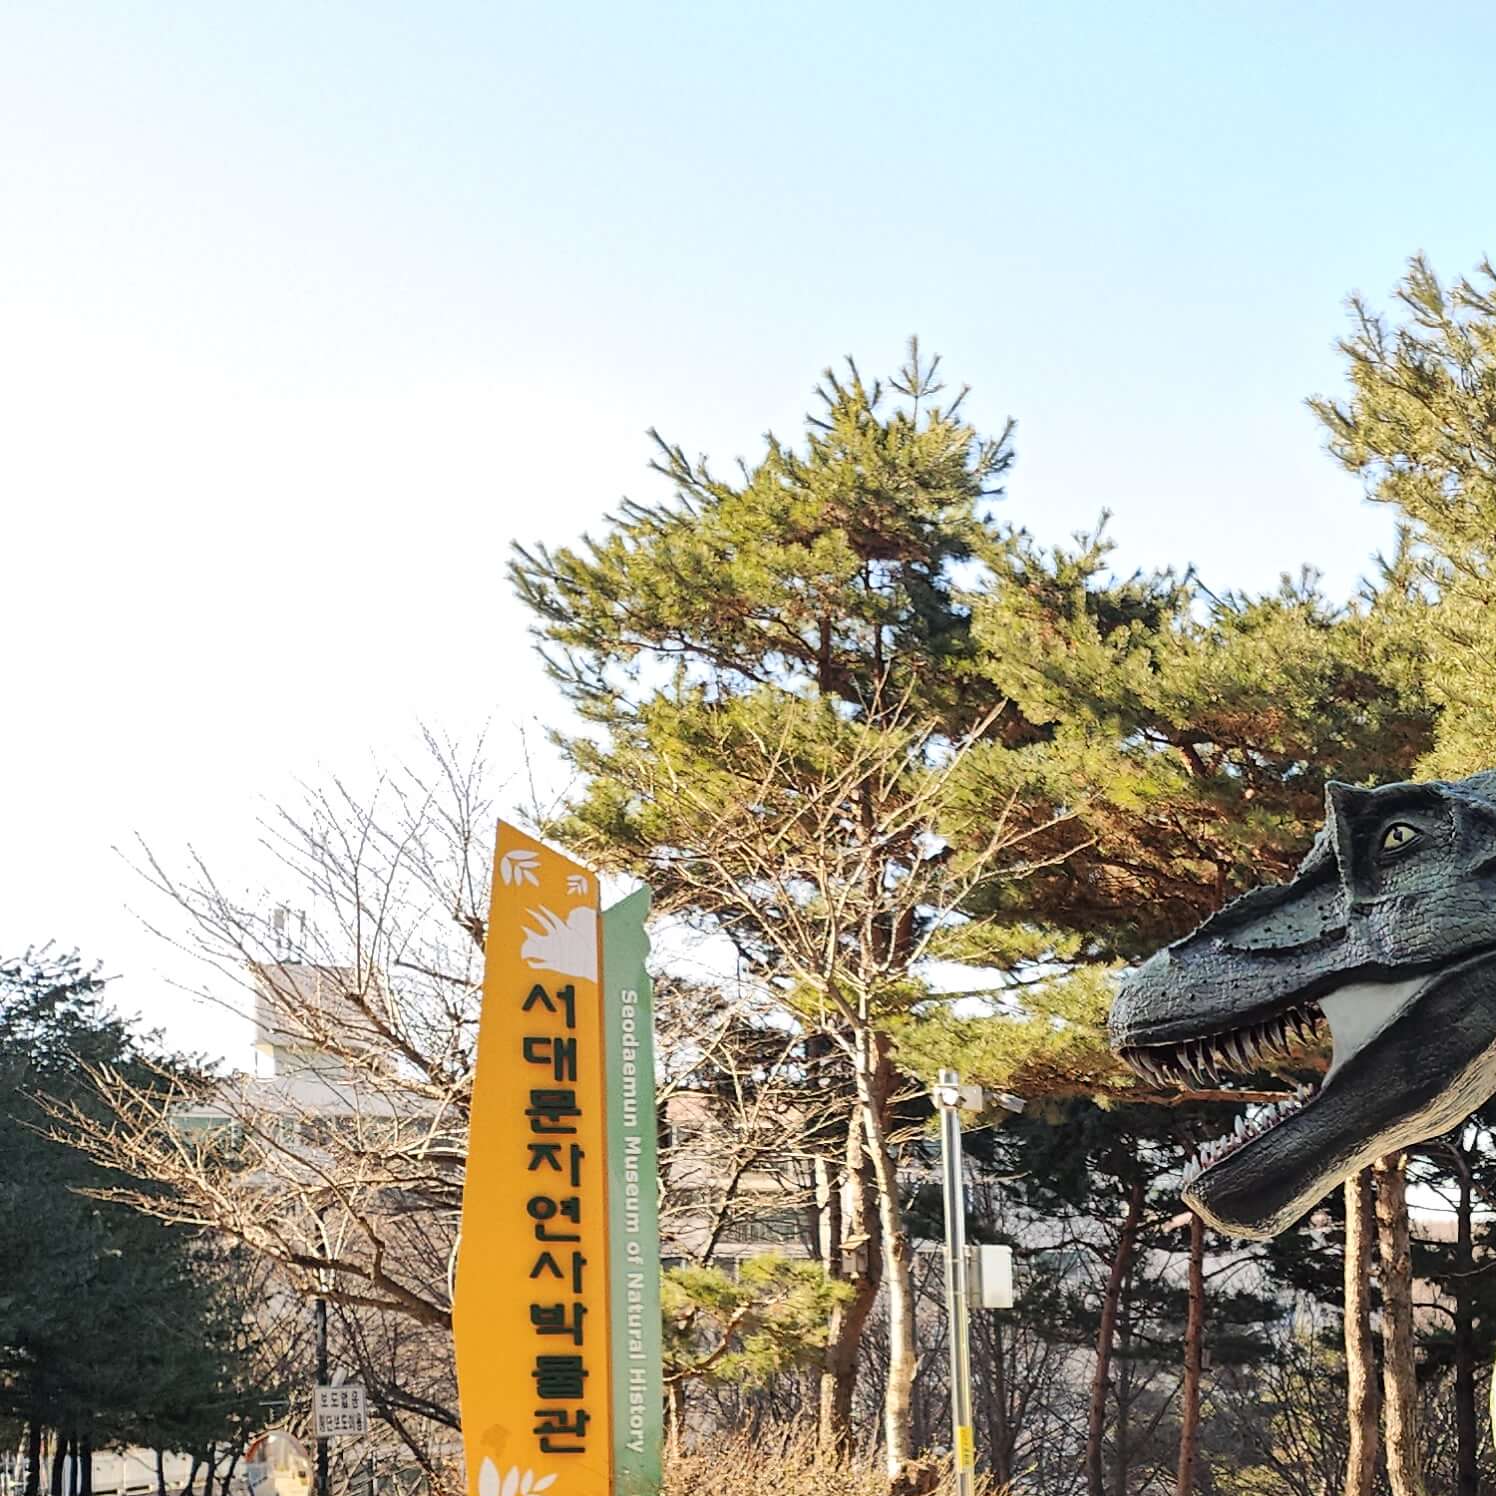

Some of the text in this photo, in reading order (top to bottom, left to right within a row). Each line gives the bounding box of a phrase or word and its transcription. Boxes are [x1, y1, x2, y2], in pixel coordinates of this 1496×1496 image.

[521, 983, 590, 1454] 서대문자연사박물관
[621, 989, 647, 1454] Seodaemun Museum of Natural History
